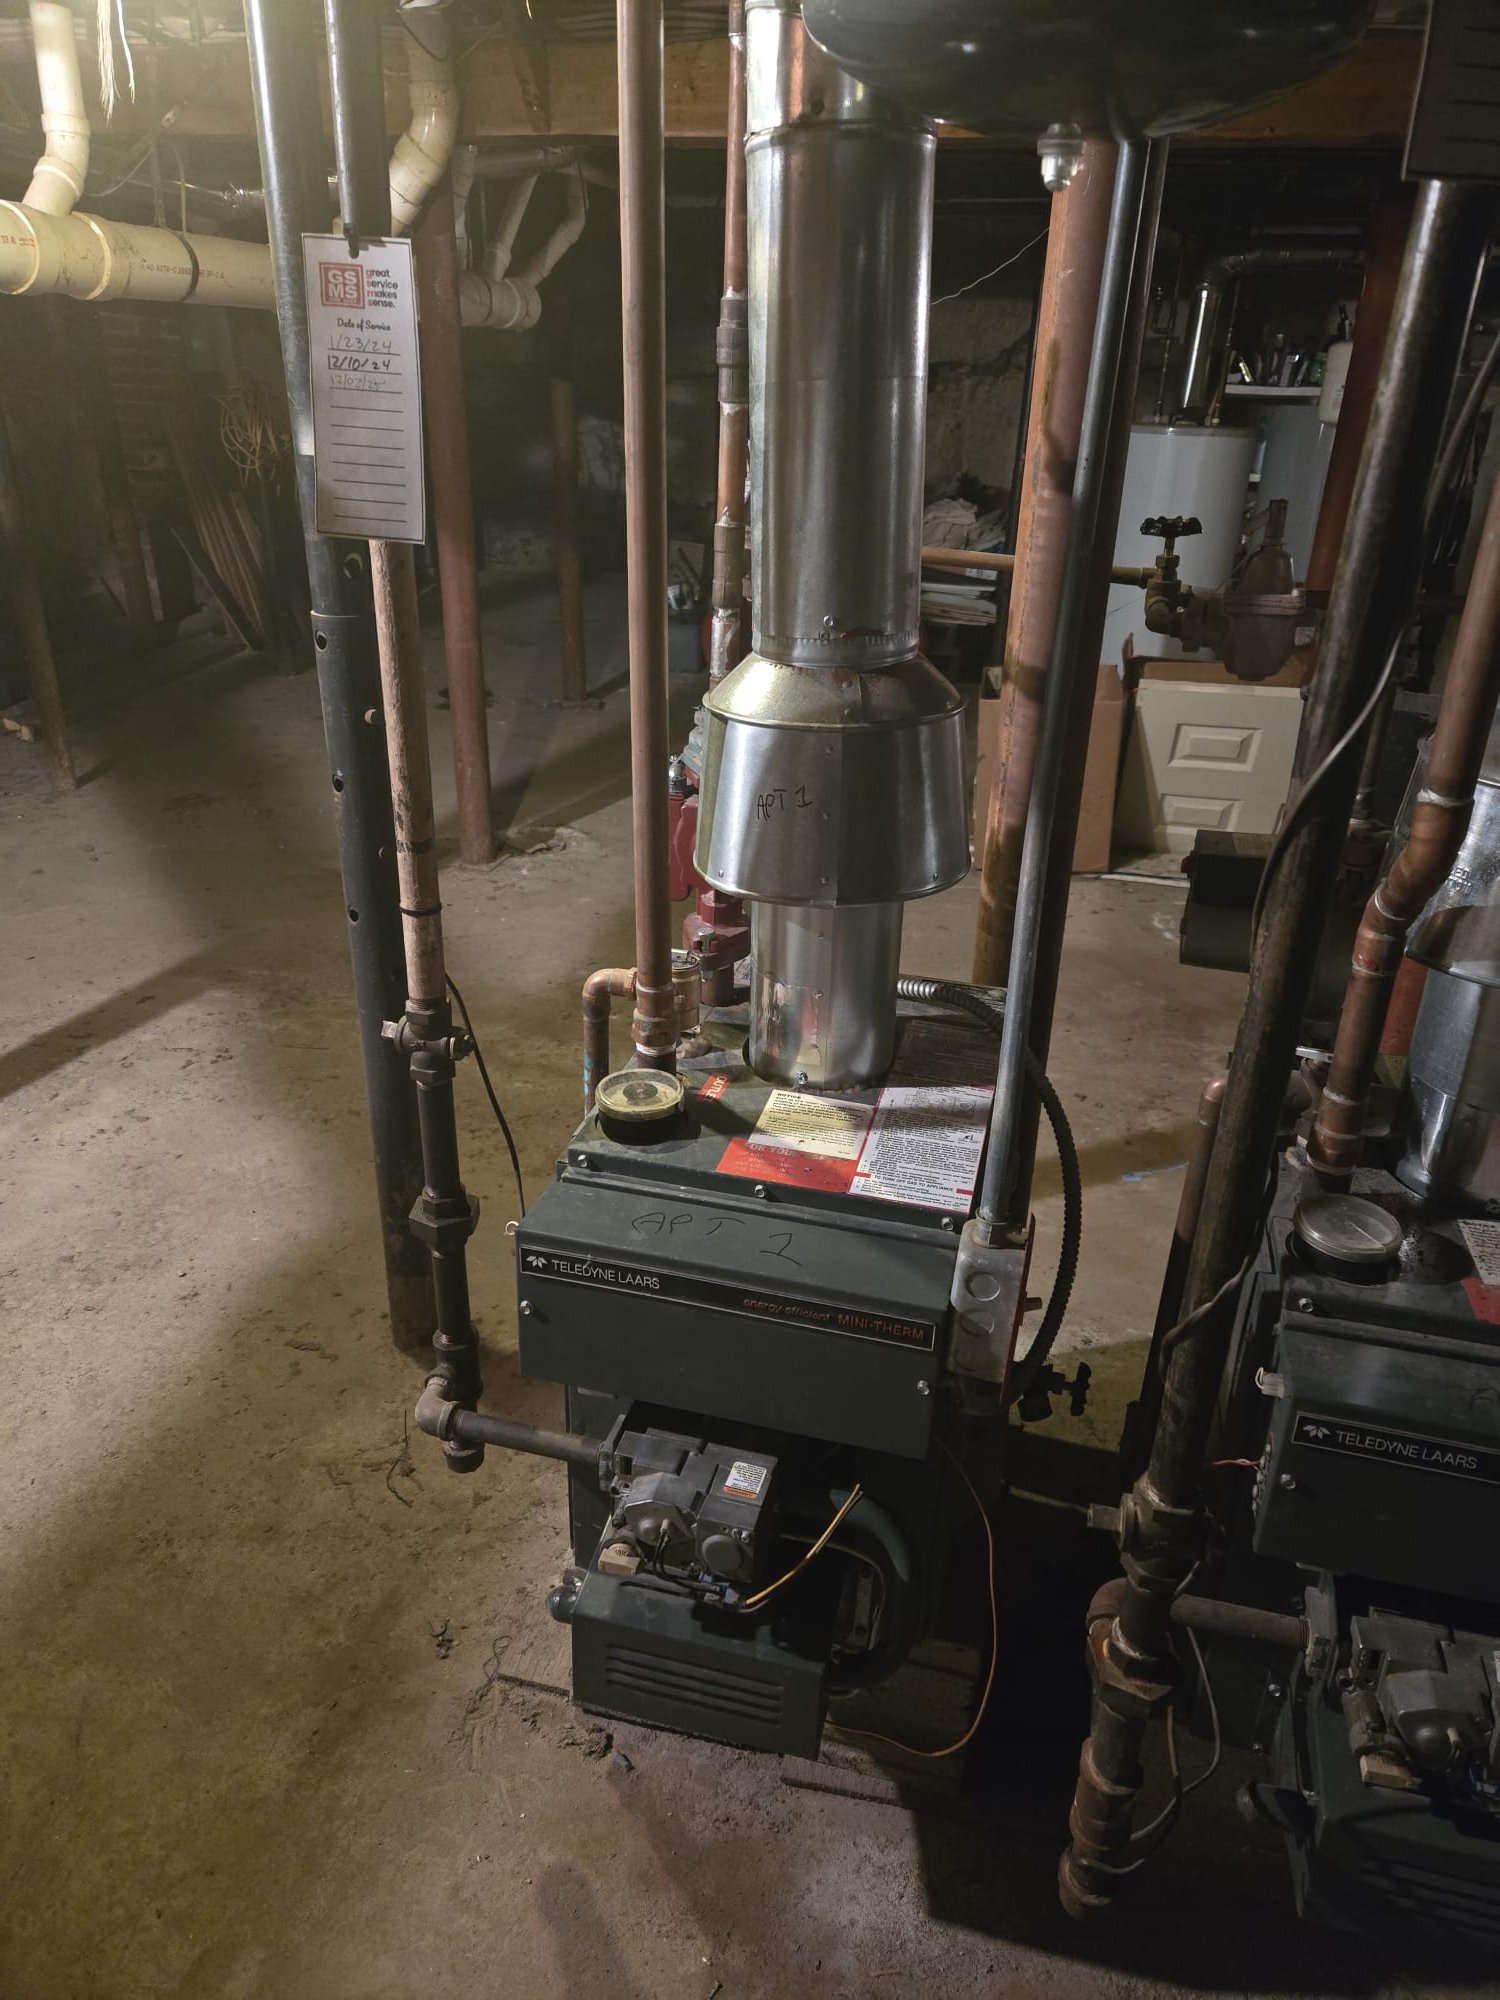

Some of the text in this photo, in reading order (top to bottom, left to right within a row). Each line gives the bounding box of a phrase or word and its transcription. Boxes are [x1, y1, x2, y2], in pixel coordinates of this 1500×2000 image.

[327, 270, 357, 284] GS
[366, 269, 390, 279] great
[328, 284, 358, 299] MS
[366, 280, 398, 290] service
[367, 290, 397, 299] makes
[367, 299, 396, 308] sense.
[337, 318, 391, 332] Date of Service
[757, 784, 813, 821] APT 1
[926, 1184, 954, 1192] APPLIANCE
[631, 1211, 746, 1236] APT
[551, 1259, 660, 1289] TELEDYNE LAARS
[1335, 1429, 1477, 1469] TELEDYNE LAARS
